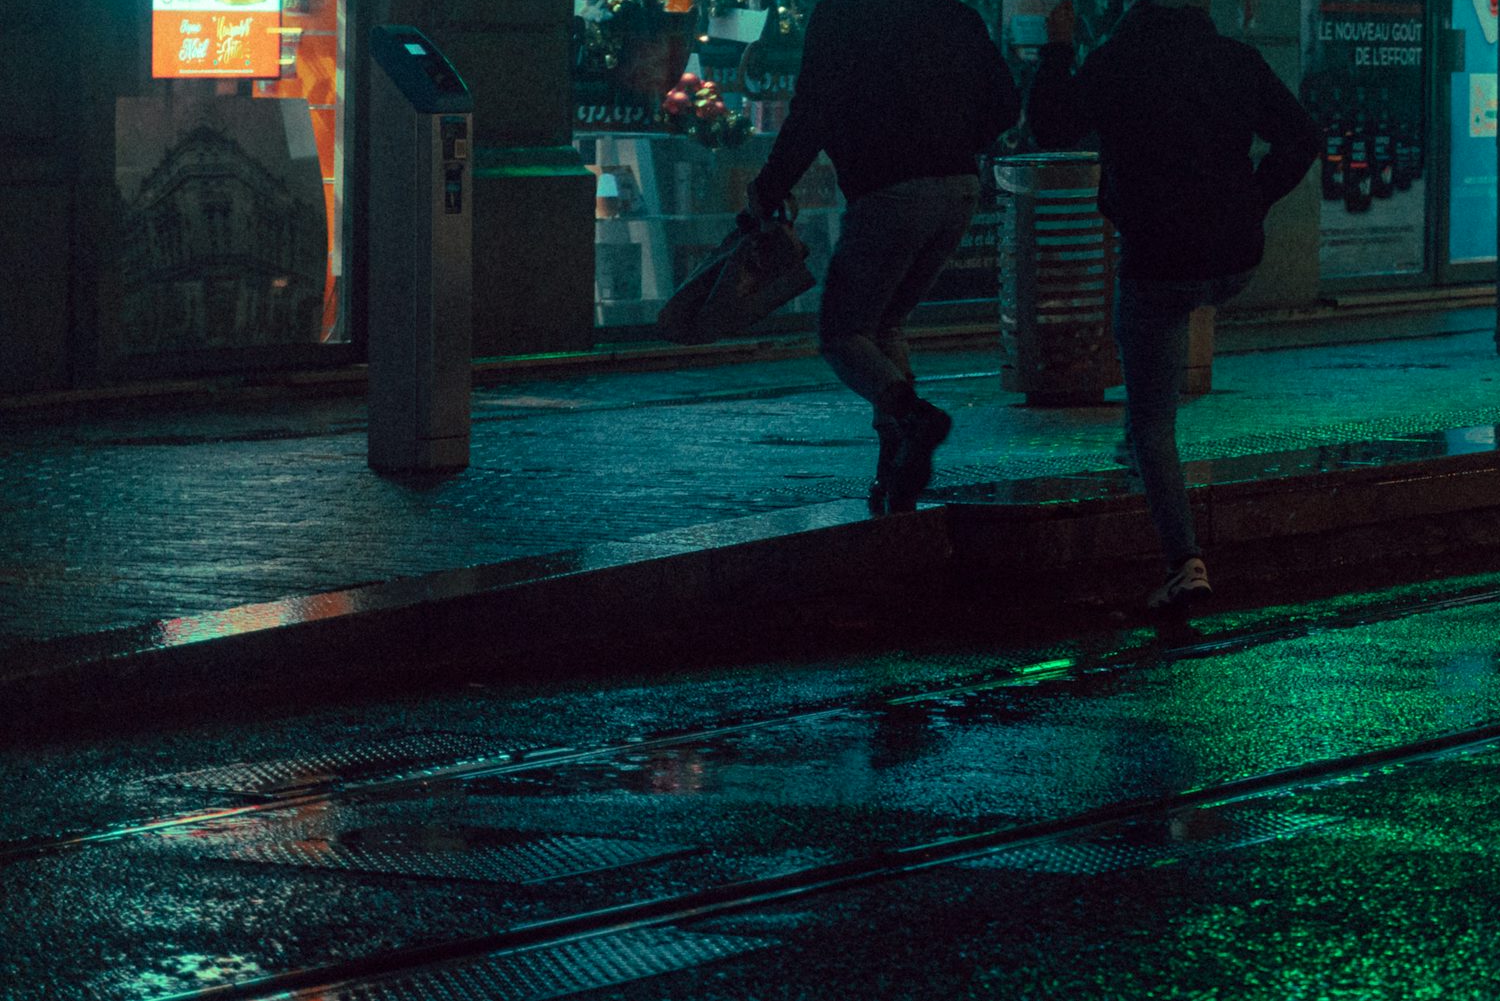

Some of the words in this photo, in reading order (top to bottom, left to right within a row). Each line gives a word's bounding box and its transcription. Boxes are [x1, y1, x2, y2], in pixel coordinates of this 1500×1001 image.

[1318, 21, 1333, 41] LE
[1335, 21, 1390, 41] NOUVEAU
[1392, 18, 1423, 42] GOÛT
[1355, 46, 1371, 66] DE
[1373, 46, 1423, 66] L'EFFORT
